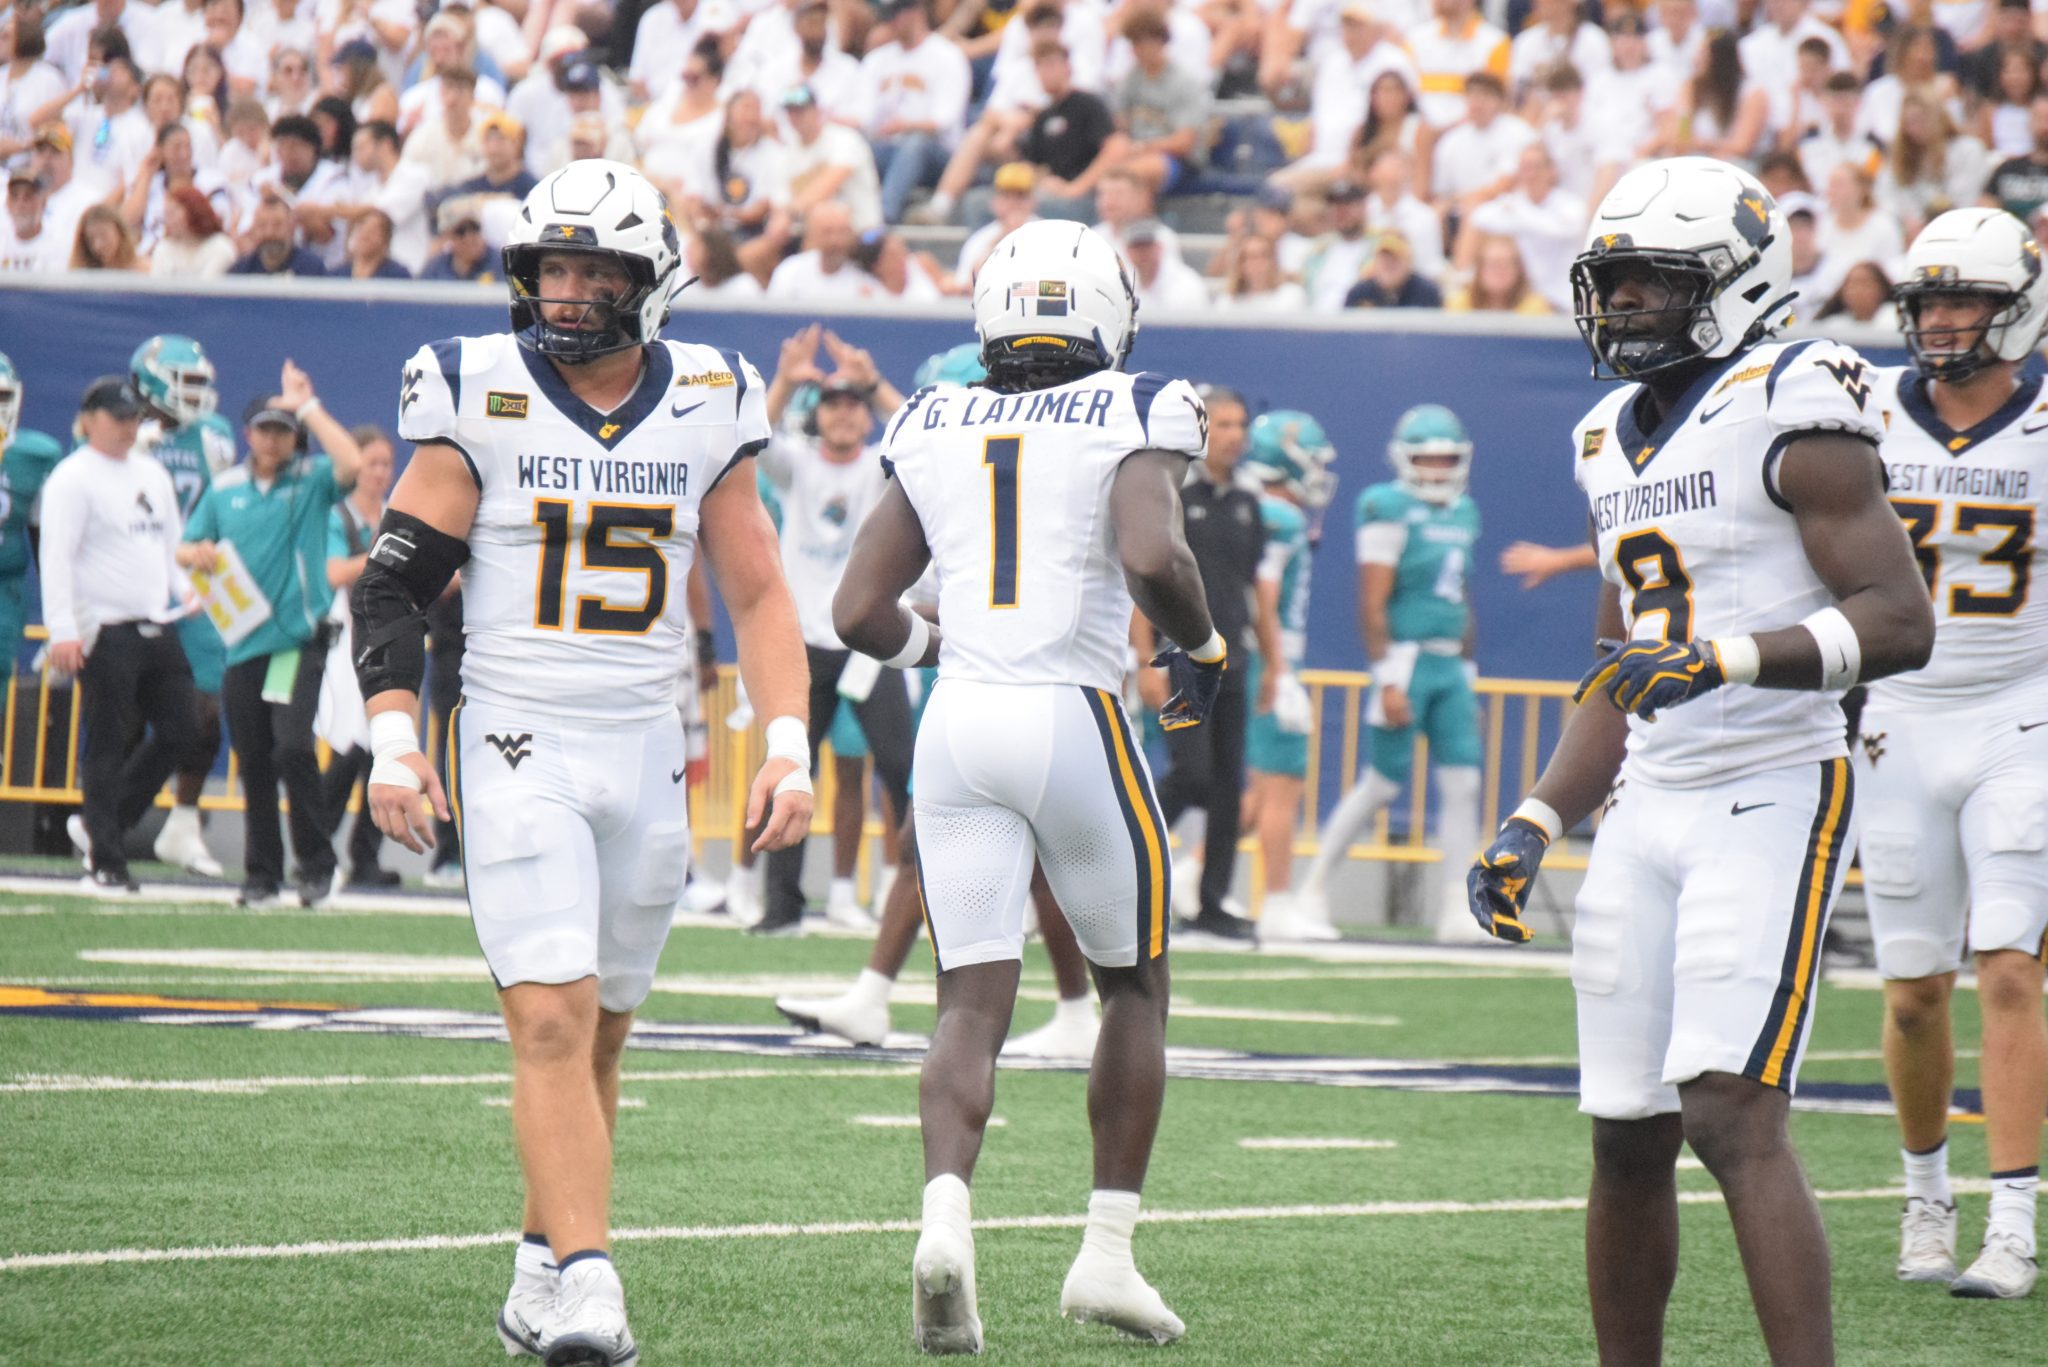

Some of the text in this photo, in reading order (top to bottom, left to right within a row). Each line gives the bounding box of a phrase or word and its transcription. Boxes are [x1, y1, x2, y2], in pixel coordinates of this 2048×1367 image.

[691, 370, 733, 386] Antero
[924, 388, 1115, 430] G. LATIMER
[518, 455, 688, 497] WEST VIRGINIA
[1624, 470, 1717, 524] VIRGINIA
[1888, 463, 2030, 500] EST VIRGINIA
[981, 433, 1024, 610] 1
[532, 496, 676, 636] 15
[1613, 526, 1695, 645] 8
